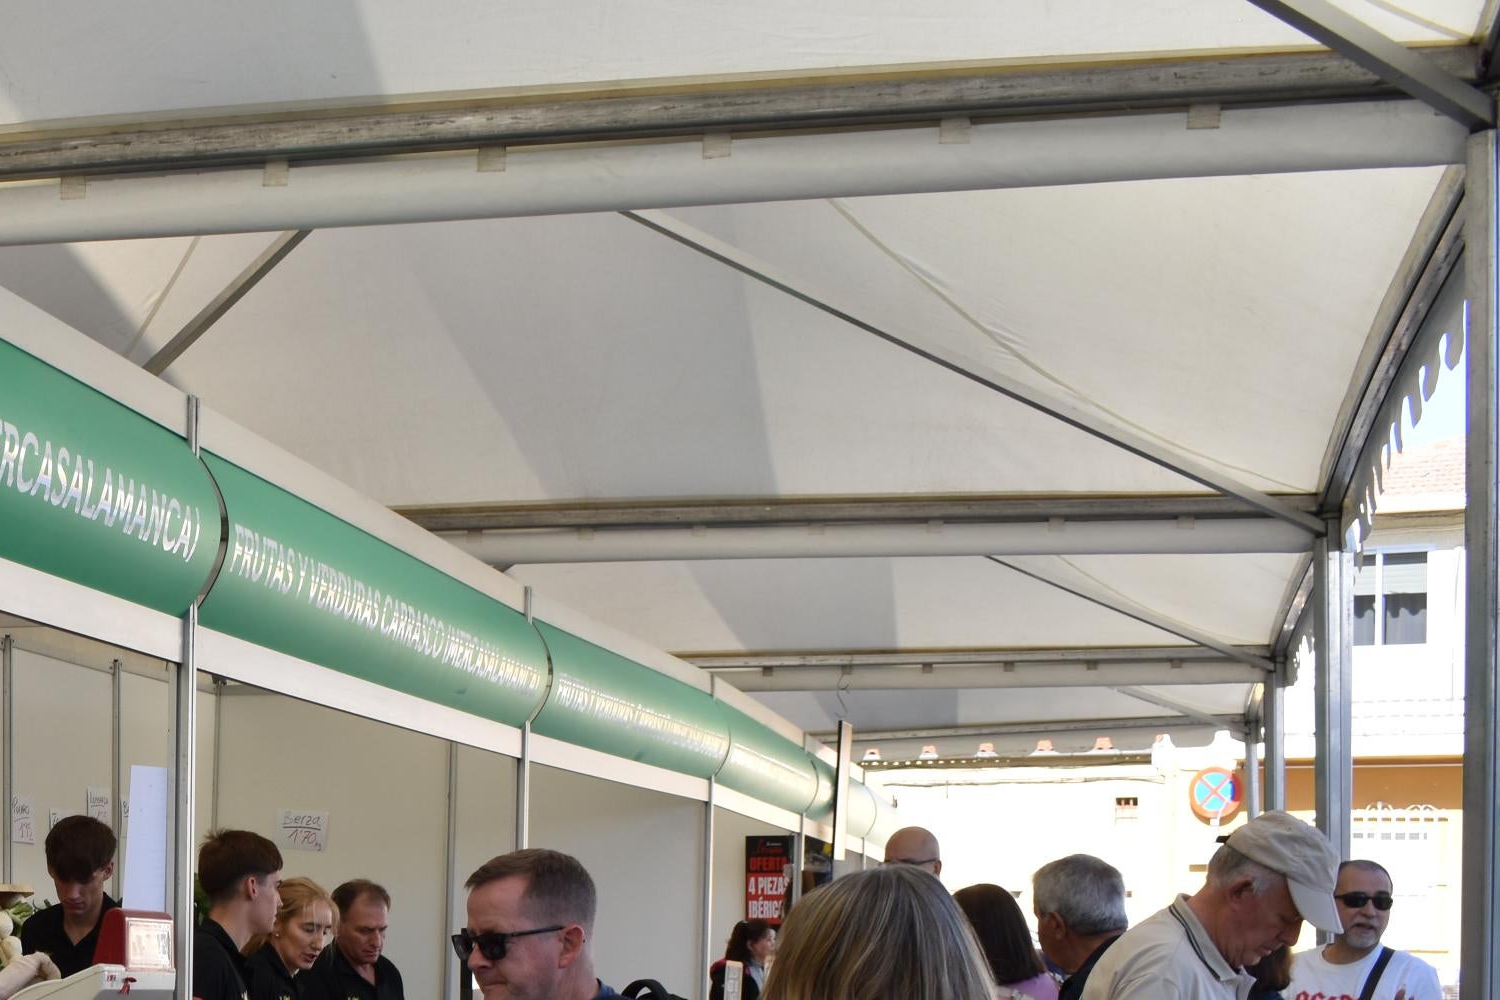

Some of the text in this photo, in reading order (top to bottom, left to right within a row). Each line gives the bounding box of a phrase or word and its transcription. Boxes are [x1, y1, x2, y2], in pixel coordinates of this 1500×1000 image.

[230, 524, 294, 594] FRUTAS
[296, 552, 309, 599] Y
[308, 558, 381, 631] VERDURAS
[748, 877, 756, 895] 4
